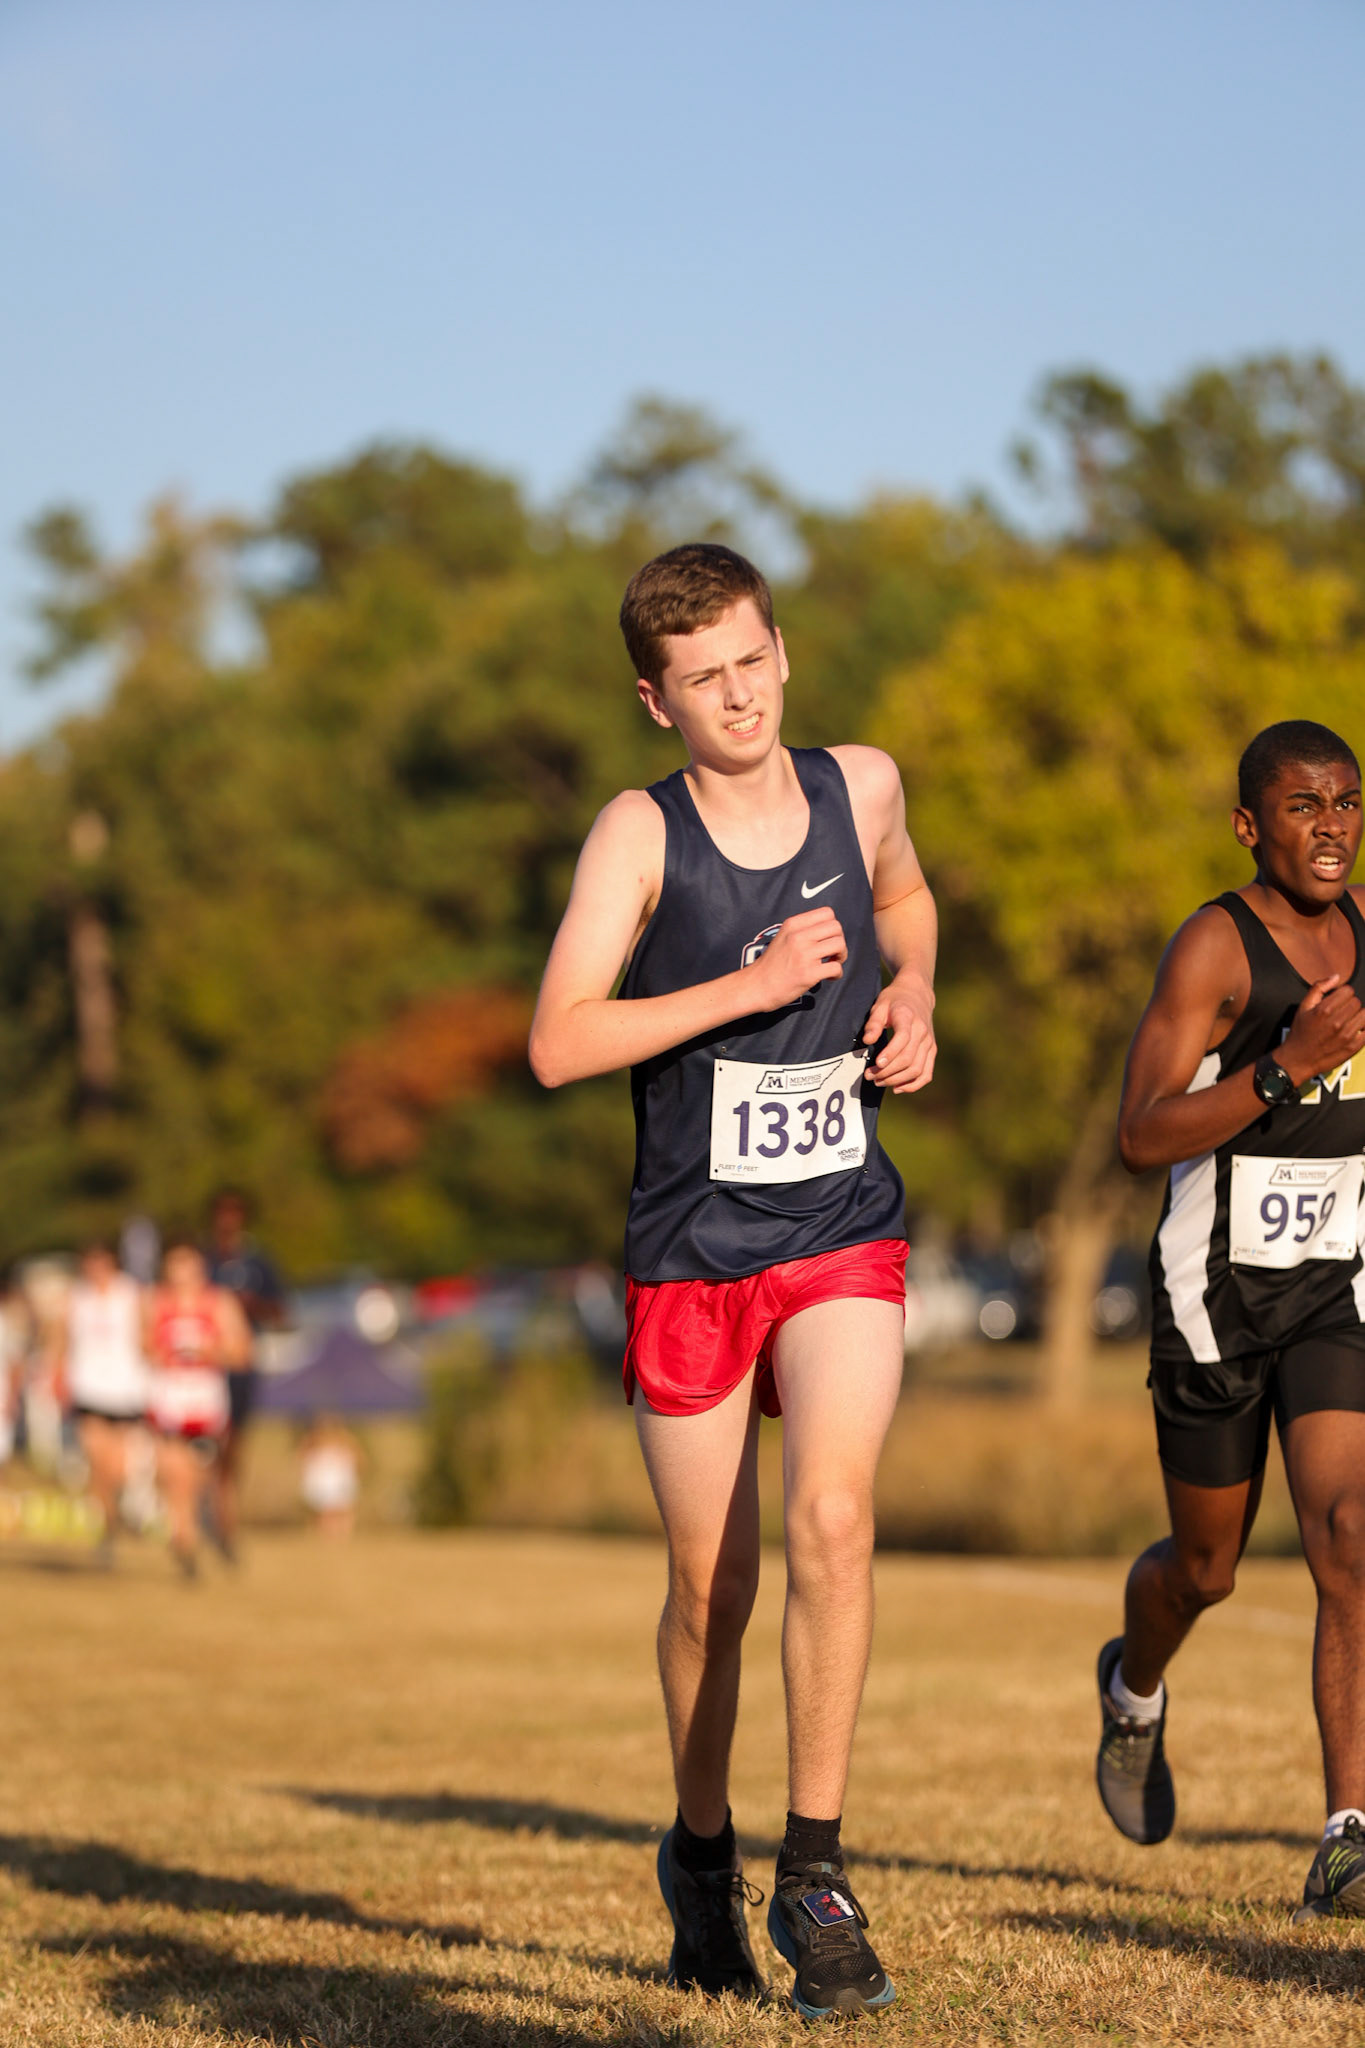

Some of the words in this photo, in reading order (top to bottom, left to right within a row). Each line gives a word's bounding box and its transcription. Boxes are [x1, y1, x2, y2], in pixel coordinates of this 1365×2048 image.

[766, 1077, 784, 1088] M
[733, 1090, 845, 1158] 1338
[718, 1163, 736, 1171] FLEET
[1279, 1169, 1293, 1180] M
[1260, 1191, 1336, 1243] 959
